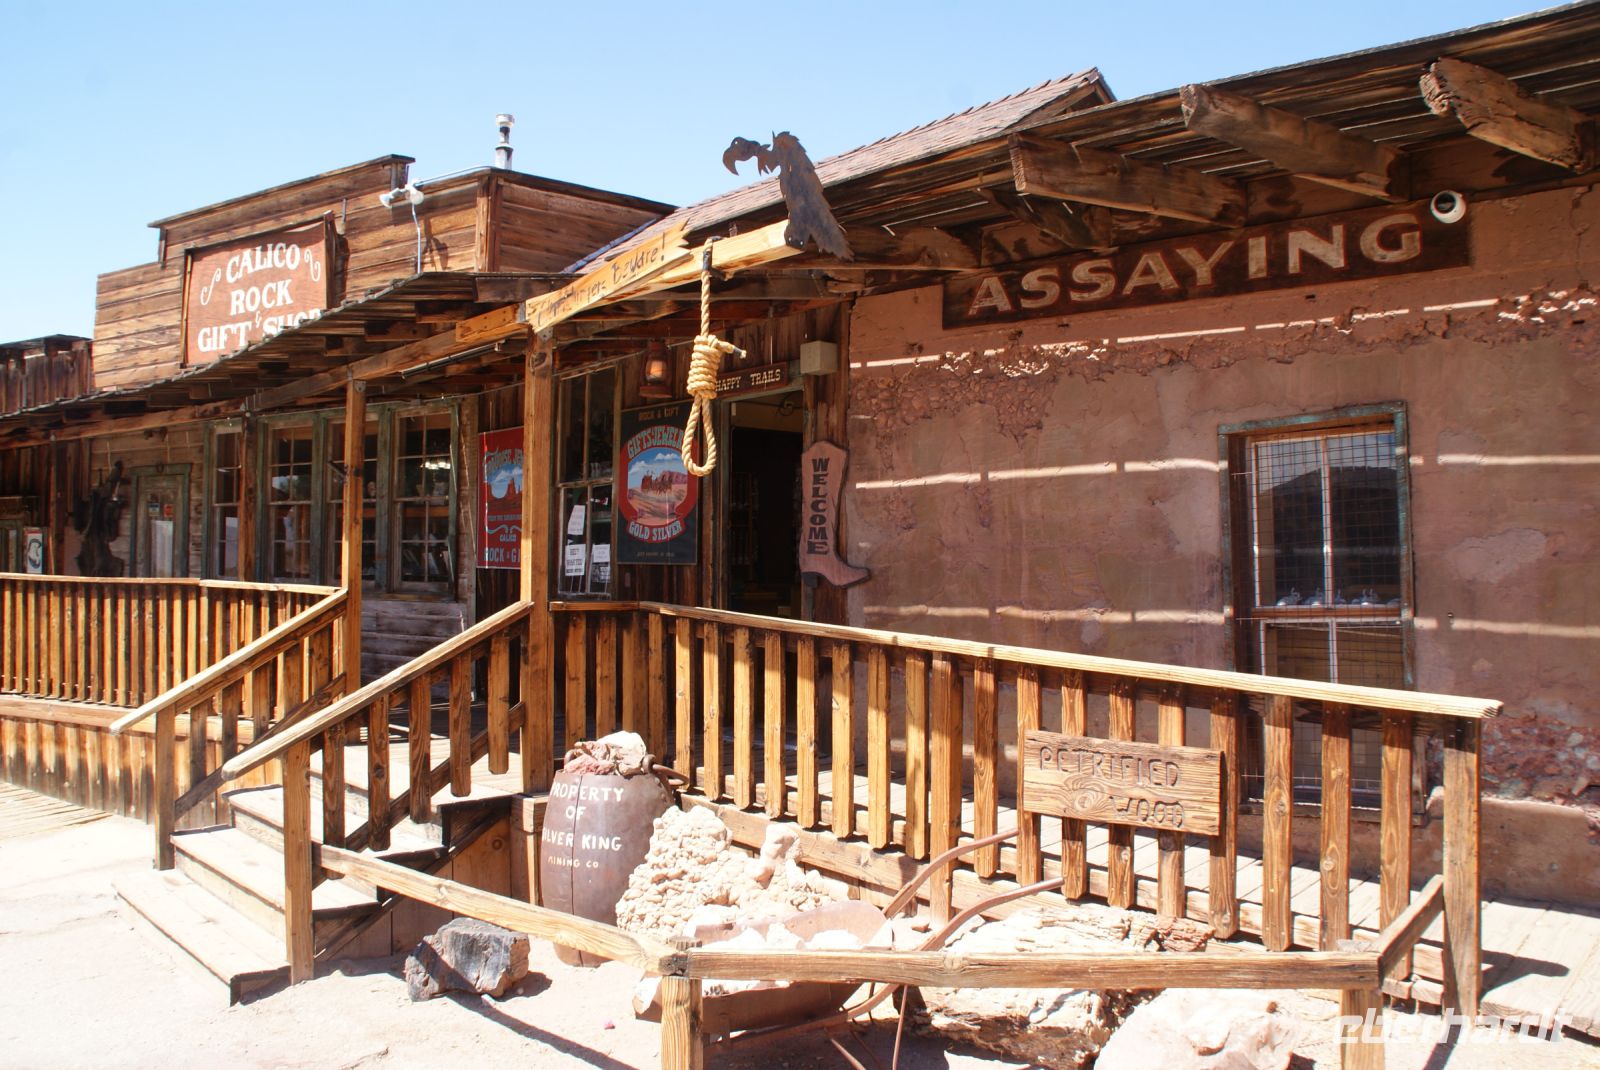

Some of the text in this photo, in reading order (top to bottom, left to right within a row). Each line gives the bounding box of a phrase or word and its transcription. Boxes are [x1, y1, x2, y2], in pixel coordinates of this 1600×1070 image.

[226, 242, 300, 283] CALICO
[967, 213, 1422, 317] ASSAYING
[229, 279, 294, 316] ROCK
[197, 321, 252, 352] GIFT
[715, 369, 781, 392] HAPPY TRAILS
[627, 426, 685, 459] GIFTS JEWELR
[807, 457, 830, 555] WELCOME
[629, 520, 682, 541] GOLD SILVER
[1039, 746, 1181, 788] PETRIFIED
[565, 805, 587, 820] OF
[1109, 795, 1185, 828] WOOD
[581, 833, 622, 852] KING
